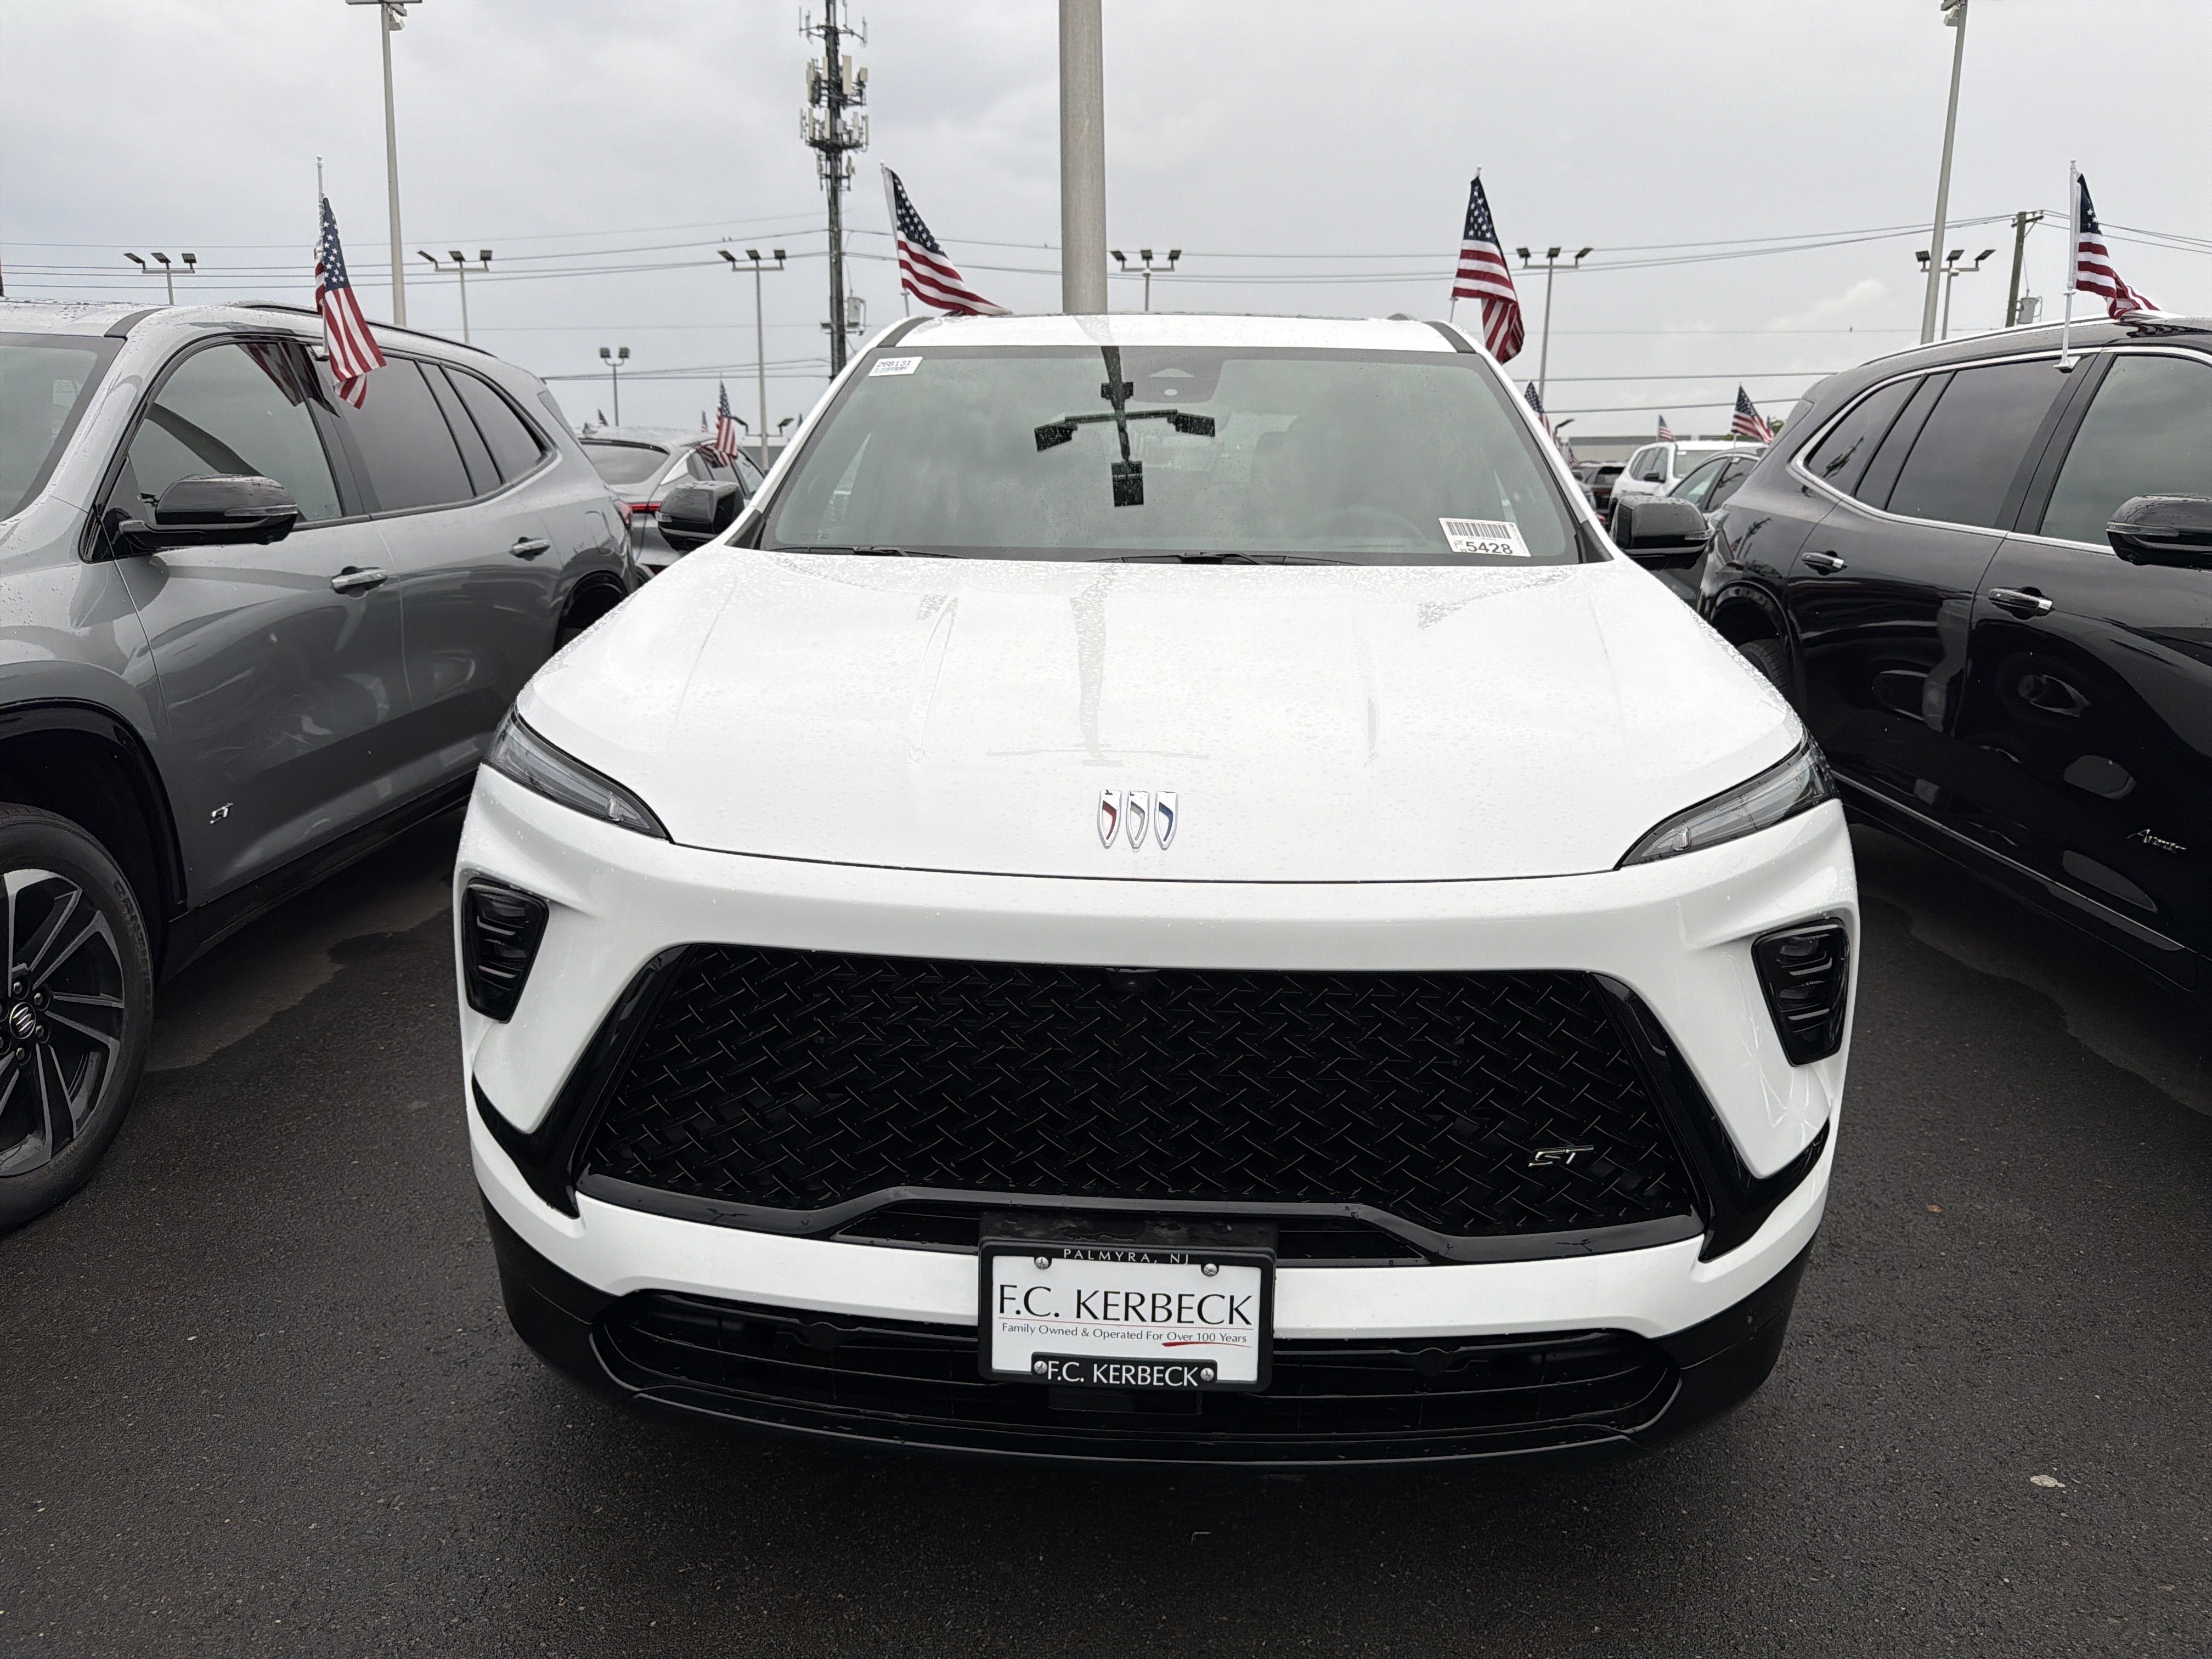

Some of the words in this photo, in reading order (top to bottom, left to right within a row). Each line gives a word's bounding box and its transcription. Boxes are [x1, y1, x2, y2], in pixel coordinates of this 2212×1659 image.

[1465, 541, 1513, 555] 5428
[1064, 1249, 1158, 1264] PALMYRA,
[1170, 1254, 1189, 1265] NJ
[999, 1284, 1060, 1318] F.C.
[1076, 1289, 1253, 1325] KERBECK
[1002, 1323, 1036, 1335] Family
[1039, 1325, 1077, 1336] Owned
[1081, 1328, 1089, 1337] &
[1093, 1328, 1143, 1340] Operated
[1147, 1331, 1163, 1340] For
[1167, 1331, 1193, 1341] Over
[1197, 1332, 1216, 1342] 100
[1220, 1333, 1246, 1342] Years
[1047, 1361, 1085, 1383] F.C.
[1093, 1363, 1198, 1386] KERBECK
